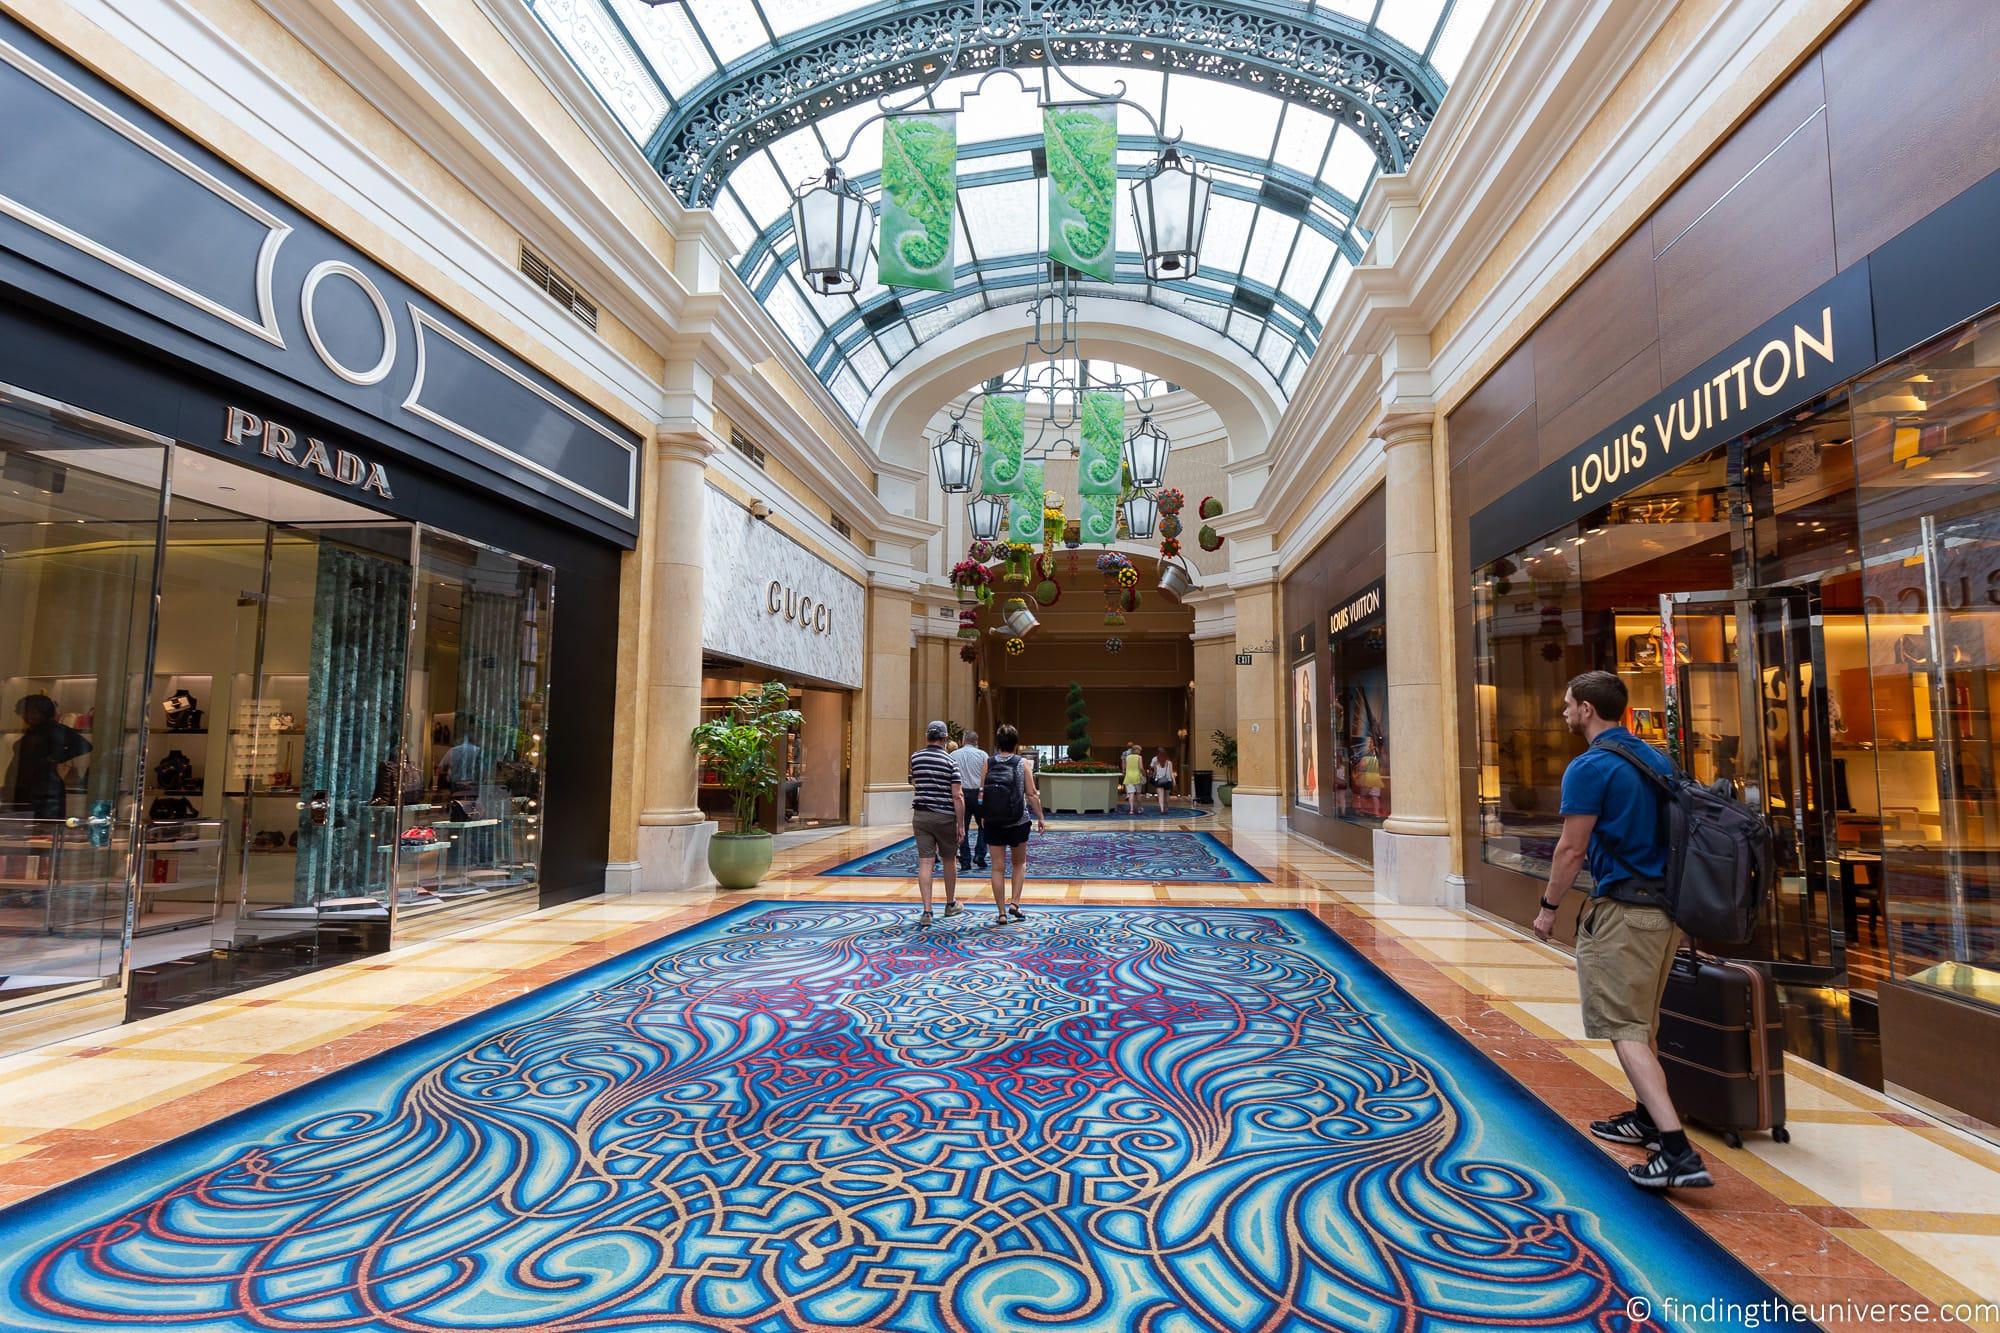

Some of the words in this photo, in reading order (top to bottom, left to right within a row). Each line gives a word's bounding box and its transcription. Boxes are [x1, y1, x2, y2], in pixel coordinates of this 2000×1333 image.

[1571, 424, 1647, 502] LOUIS
[1653, 306, 1834, 454] VUITTON
[224, 406, 395, 500] PRADA
[766, 580, 832, 636] GUCCI
[1330, 607, 1349, 634] LOUIS
[1349, 587, 1380, 624] VUITTON
[1237, 655, 1251, 665] EXIT
